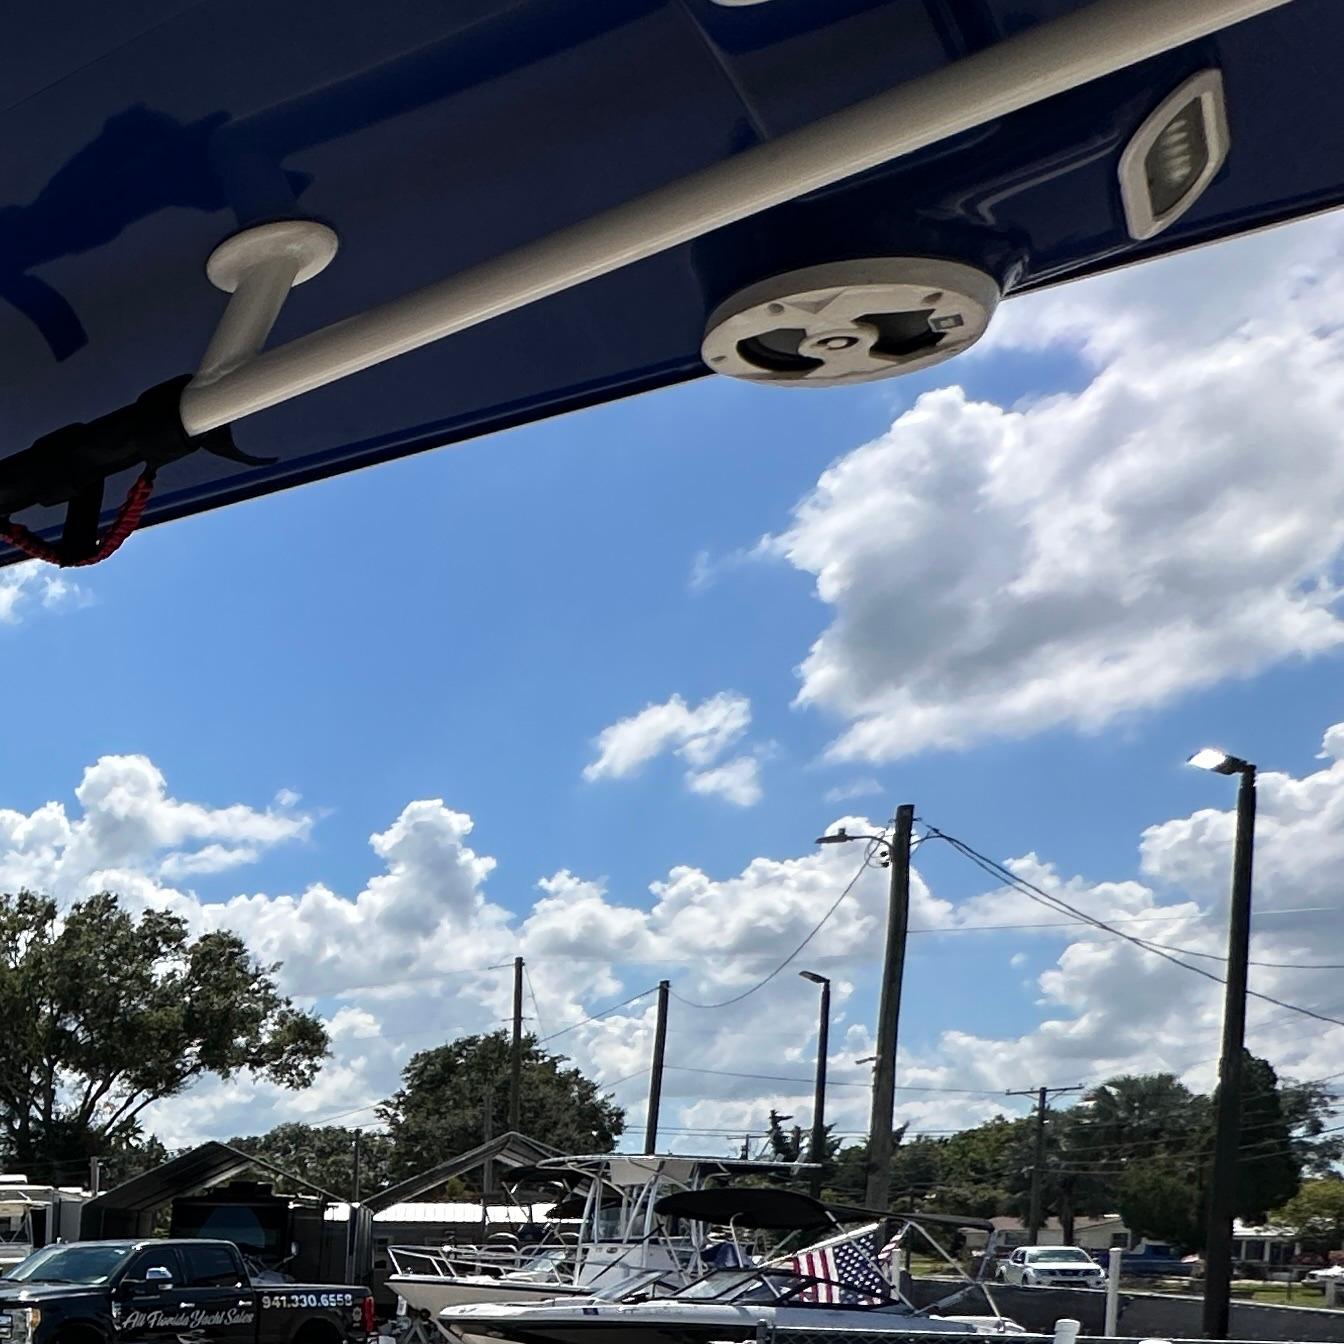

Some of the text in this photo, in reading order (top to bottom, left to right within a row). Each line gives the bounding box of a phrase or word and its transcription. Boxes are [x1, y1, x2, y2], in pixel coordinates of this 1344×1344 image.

[261, 1293, 353, 1309] 941.330.6558
[122, 1307, 254, 1329] All Florida Yacht Sales
